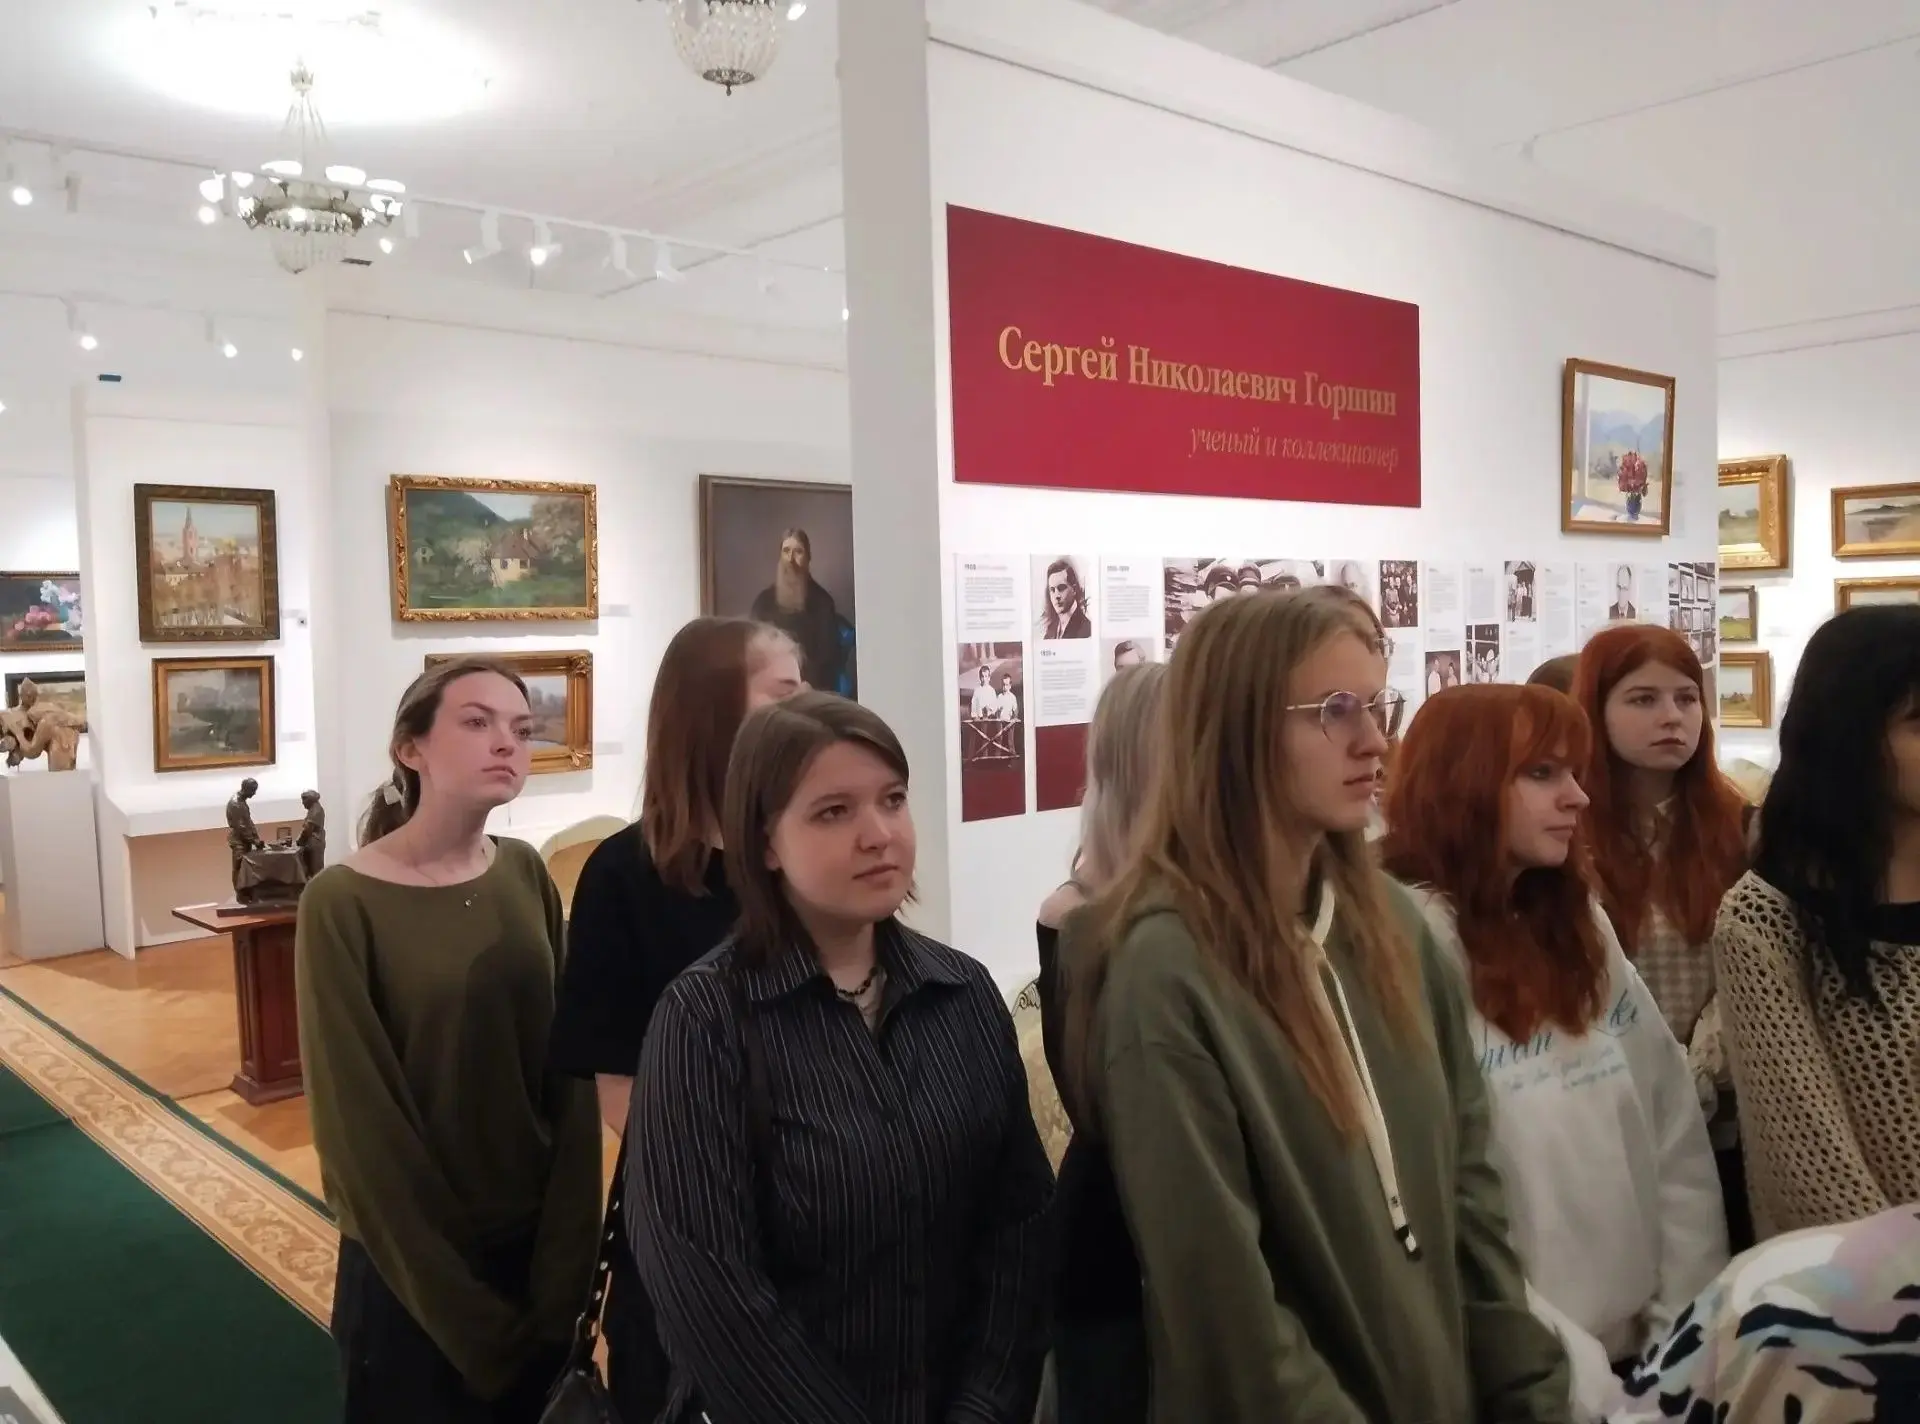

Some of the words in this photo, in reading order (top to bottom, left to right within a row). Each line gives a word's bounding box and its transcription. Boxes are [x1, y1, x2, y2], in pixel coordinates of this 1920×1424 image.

[998, 325, 1119, 388] Сергей
[1127, 344, 1297, 405] Николаевич
[1304, 371, 1397, 421] Горшин
[1188, 426, 1260, 459] ученый
[1265, 435, 1277, 457] и
[1282, 437, 1399, 474] коллекционер
